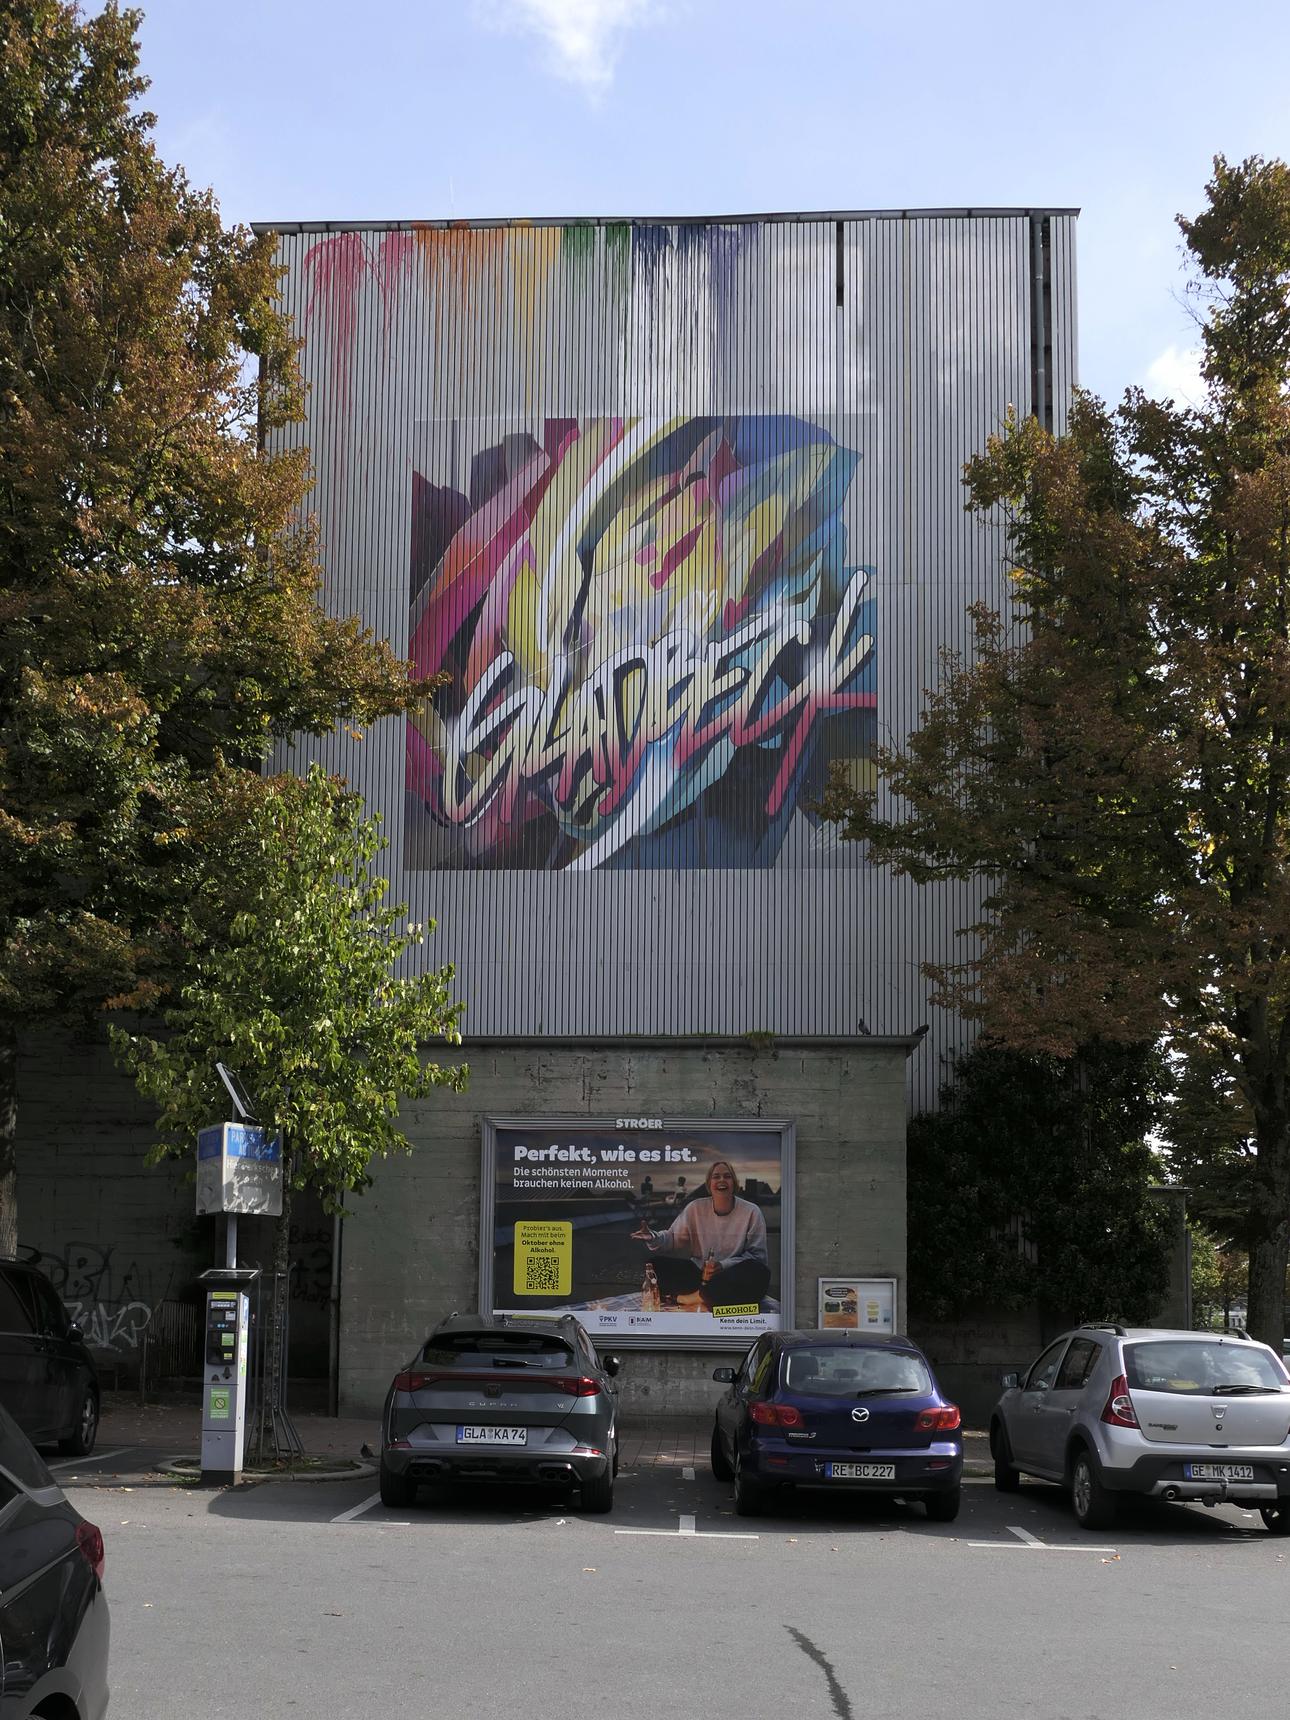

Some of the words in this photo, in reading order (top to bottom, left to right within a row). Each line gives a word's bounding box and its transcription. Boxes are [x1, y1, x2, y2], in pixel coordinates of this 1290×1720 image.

[616, 1118, 662, 1129] STRÖER
[514, 1145, 597, 1164] Perfekt,
[601, 1145, 636, 1162] wie
[639, 1150, 661, 1162] es
[664, 1145, 697, 1162] ist.
[513, 1167, 530, 1177] Die
[531, 1166, 581, 1178] schönsten
[582, 1167, 629, 1177] Momente
[513, 1178, 559, 1188] brauchen
[560, 1178, 593, 1188] keinen
[595, 1179, 635, 1189] Alkohol.
[715, 1305, 758, 1315] ALKOHOL?
[464, 1428, 487, 1439] GLA
[494, 1429, 509, 1440] KA
[511, 1429, 526, 1440] 74
[832, 1465, 847, 1476] RE
[855, 1465, 870, 1477] BC
[872, 1466, 894, 1477] 227
[1191, 1465, 1206, 1477] GE
[1212, 1465, 1226, 1478] MK
[1227, 1466, 1252, 1478] 1412
